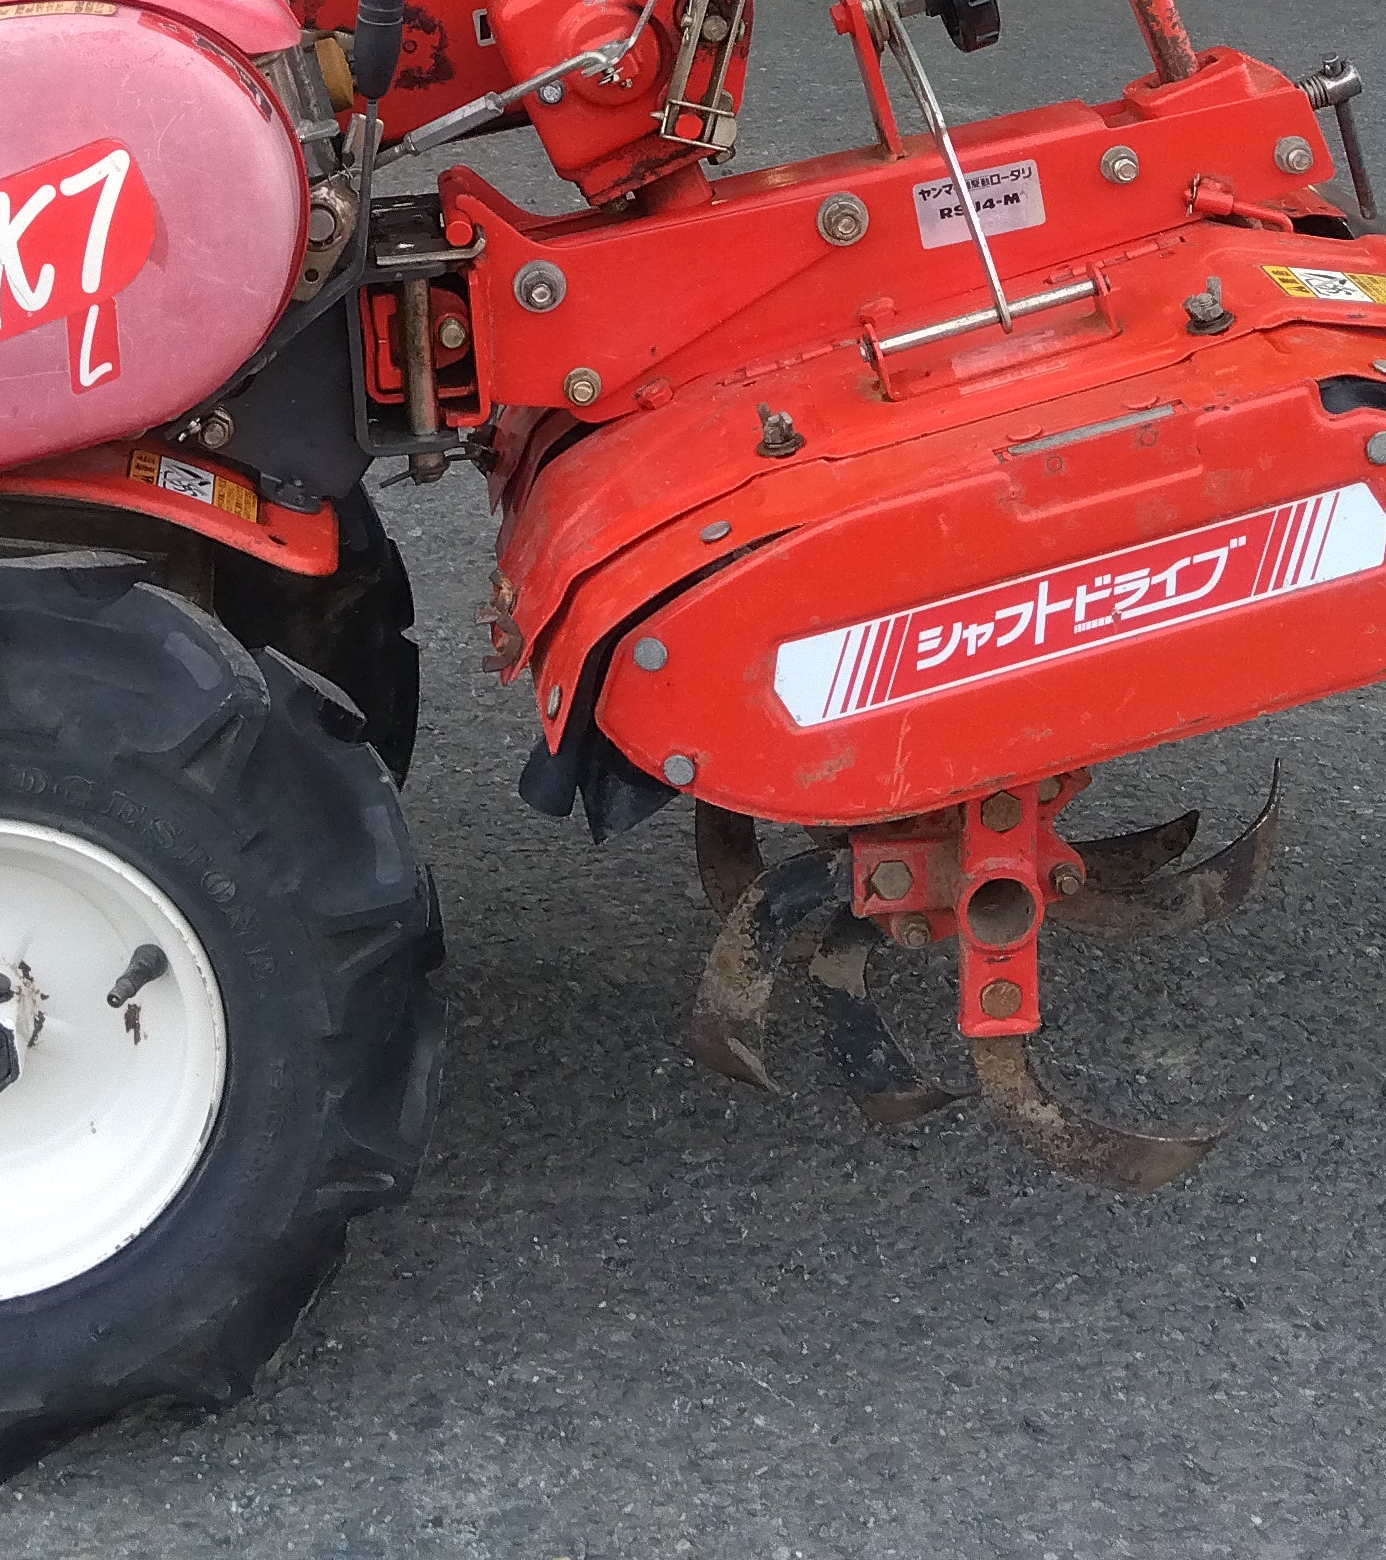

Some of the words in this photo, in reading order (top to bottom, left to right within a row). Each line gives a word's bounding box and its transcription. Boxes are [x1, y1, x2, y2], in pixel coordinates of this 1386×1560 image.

[916, 536, 1247, 671] シャフトドライブ
